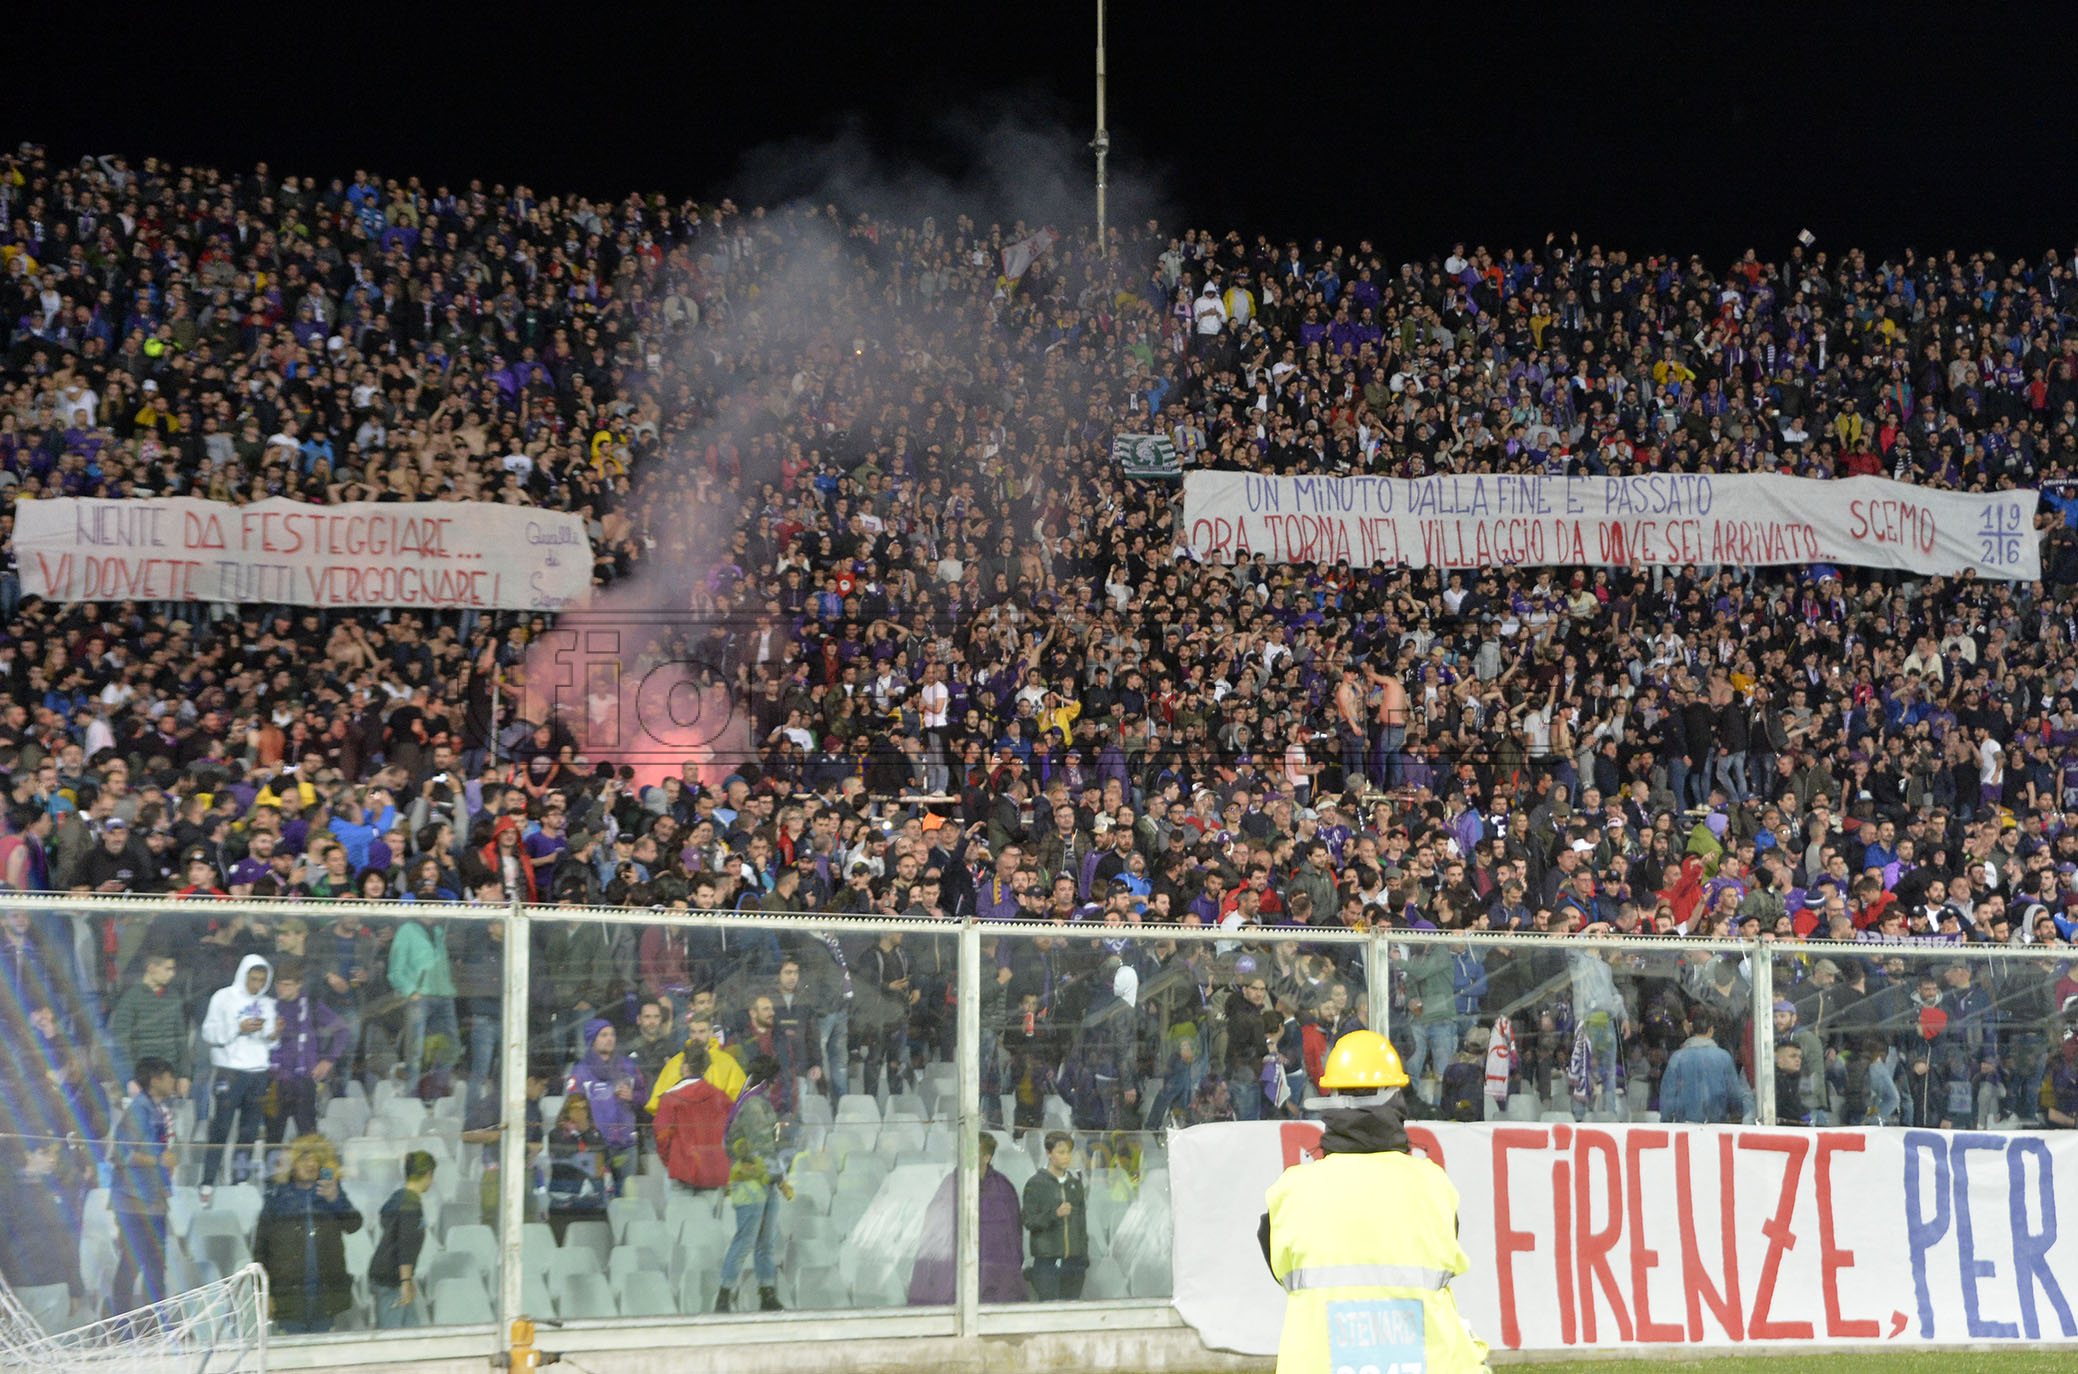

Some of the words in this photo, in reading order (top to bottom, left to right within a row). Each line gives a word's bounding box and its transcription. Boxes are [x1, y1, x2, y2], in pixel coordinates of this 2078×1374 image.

[1246, 476, 1279, 513] UN
[1408, 476, 1489, 516] DALLA
[1605, 475, 1712, 516] PASSATO
[184, 510, 225, 549] DA
[1193, 515, 1250, 560] ORA
[1264, 514, 1350, 564] TORNA
[1556, 519, 1586, 564] DA
[1600, 520, 1655, 566] DOVE
[1850, 499, 1936, 554] SCEMO
[37, 552, 73, 598] VI
[83, 555, 203, 600] DOVETE
[215, 560, 295, 600] TUTTI
[1903, 1130, 2078, 1340] PER
